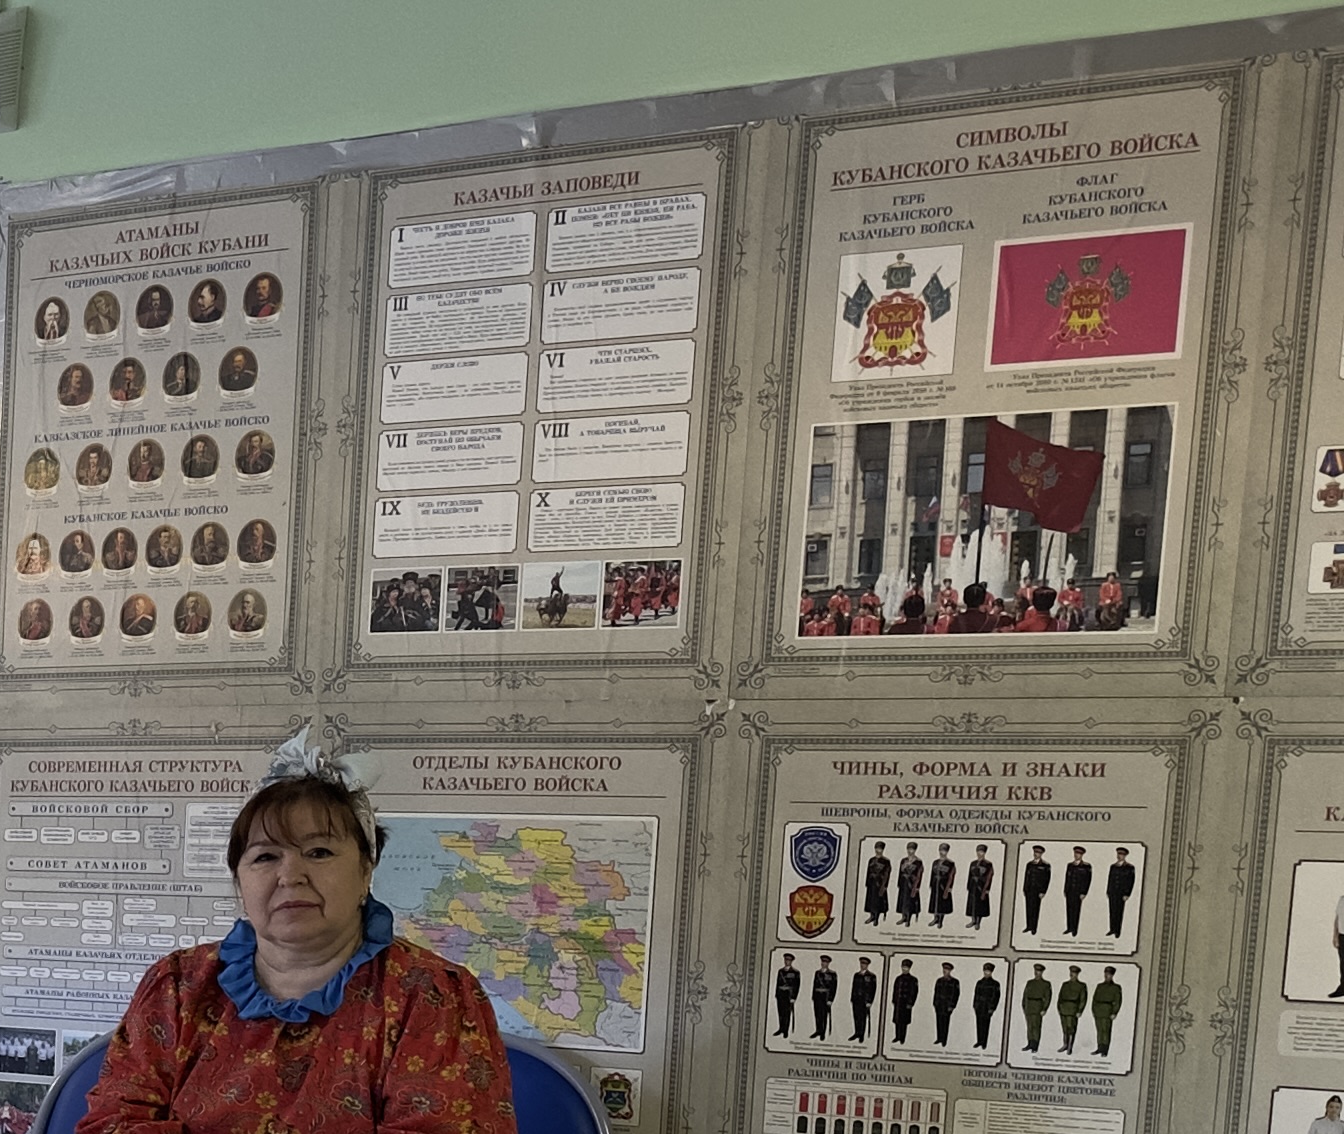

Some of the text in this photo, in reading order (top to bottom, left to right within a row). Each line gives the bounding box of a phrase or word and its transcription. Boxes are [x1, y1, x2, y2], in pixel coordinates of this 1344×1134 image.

[956, 121, 1069, 149] СИМВОЛЫ
[832, 132, 1199, 187] КУБАНСКОГО КАЗАЧЬЕГО ВОЙСКА
[1076, 173, 1119, 187] ФЛАГ
[453, 171, 640, 206] КАЗАЧЬИ ЗАПОВЕДИ
[1048, 186, 1145, 206] КУБАНСКОГО
[892, 193, 926, 206] ГЕРБ
[862, 206, 953, 225] КУБАНСКОГО
[1022, 200, 1167, 225] КАЗАЧЬЕГО ВОЙСКА
[115, 221, 200, 244] АТАМАНЫ
[838, 219, 975, 242] КАЗАЧЬЕГО ВОЙСКА
[49, 233, 269, 273] КАЗАЧЬИХ ВОЙСК КУБАНИ
[65, 257, 251, 290] ЧЕРНОМОРСКОЕ КАЗАЧЬЕ ВОЙСКО
[550, 282, 567, 297] IV
[393, 296, 409, 311] III
[546, 353, 565, 368] VI
[389, 365, 401, 380] V
[34, 414, 270, 444] КАВКАЗСКОЕ ЛИНЕЙНОЕ КАЗАЧЬЕ ВОЙСКО
[542, 423, 569, 439] VIII
[386, 433, 408, 448] VII
[64, 503, 229, 525] КУБАНСКОЕ КАЗАЧЬЕ ВОЙСКО
[381, 501, 401, 515] IX
[28, 760, 243, 774] СОВРЕМЕННАЯ СТРУКТУРА
[412, 755, 622, 771] ОТДЕЛЫ КУБАНСКОГО
[832, 761, 1107, 778] ЧИНЫ, ФОРМА И ЗНАКИ
[10, 778, 253, 794] КУБАНСКОГО КАЗАЧЬЕГО ВОЙСК
[422, 774, 609, 792] КАЗАЧЬЕГО ВОЙСКА
[877, 784, 1053, 802] РАЗЛИЧИЯ ККВ
[31, 803, 149, 815] ВОЙСКОВОЙ СБОР
[821, 807, 1111, 823] ШЕВРОНЫ, ФОРМА ОДЕЖДЫ КУБАНСКОГО
[893, 821, 1029, 835] КАЗАЧЬЕГО ВОЙСКА
[28, 860, 148, 871] СОВЕТ АТАМАНОВ
[806, 1058, 895, 1072] ЧИНЫ И ЗНАКИ
[788, 1068, 913, 1084] РАЗЛИЧИЯ ПО ЧИНАМ
[963, 1069, 1115, 1087] ПОГОНЫ ЧЛЕНОВ КАЗАЧЬИХ
[1014, 1083, 1054, 1093] ИМЕЮТ
[1058, 1086, 1116, 1097] ЦВЕТОВЫЕ
